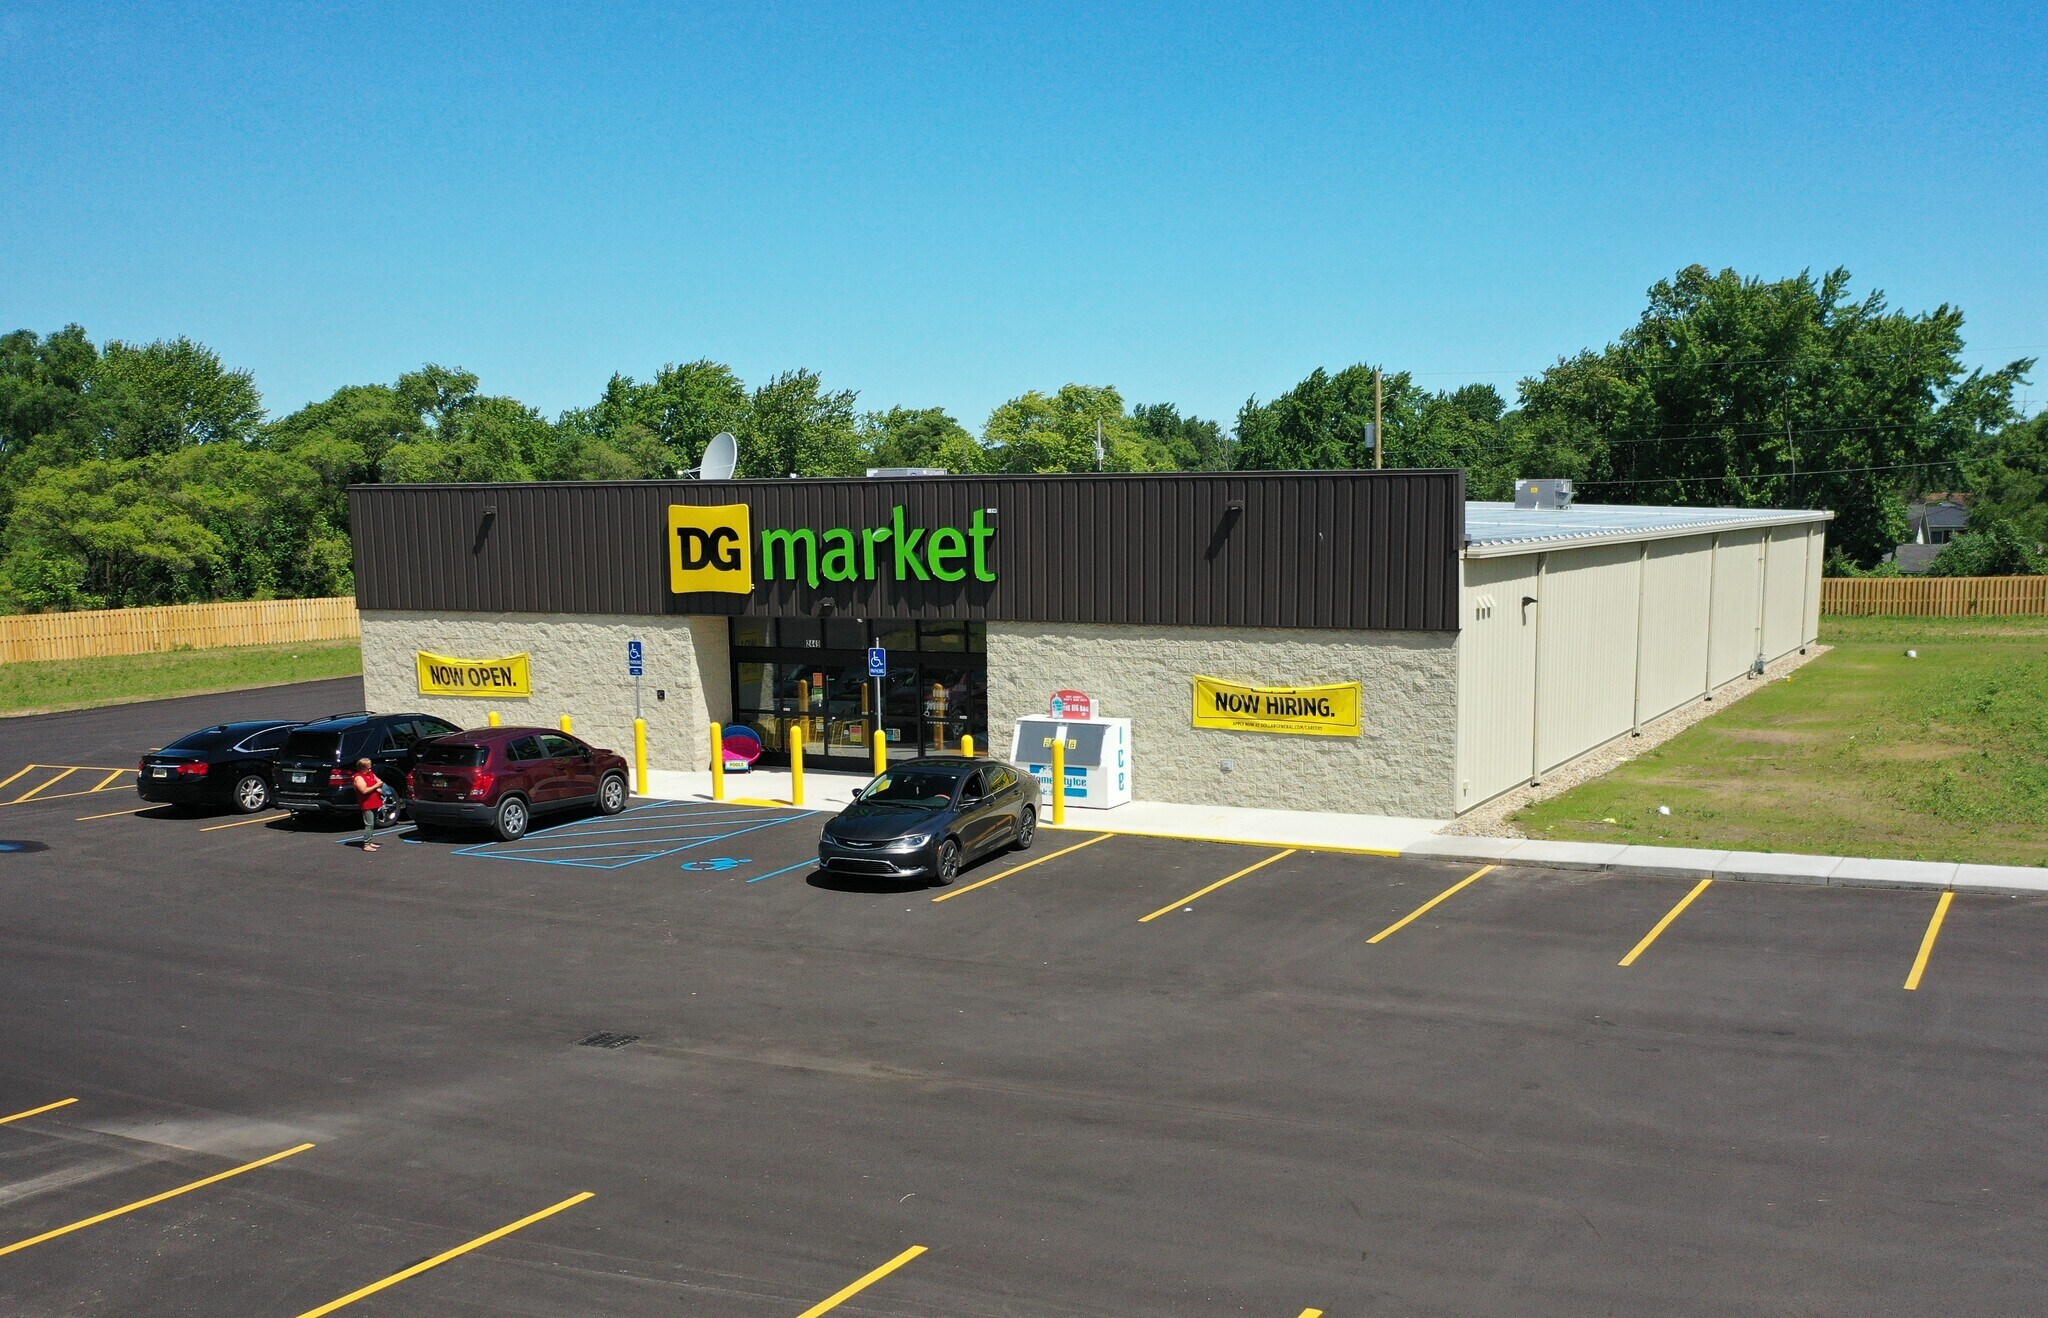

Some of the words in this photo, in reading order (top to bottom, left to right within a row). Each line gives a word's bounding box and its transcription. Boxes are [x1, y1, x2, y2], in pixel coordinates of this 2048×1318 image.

[676, 526, 742, 573] DG
[761, 504, 996, 590] market
[429, 665, 465, 686] NOW
[467, 666, 517, 687] OPEN.
[1215, 691, 1260, 714] NOW
[1266, 696, 1336, 717] HIRING.
[1034, 775, 1053, 784] ome
[1073, 778, 1087, 787] Ice
